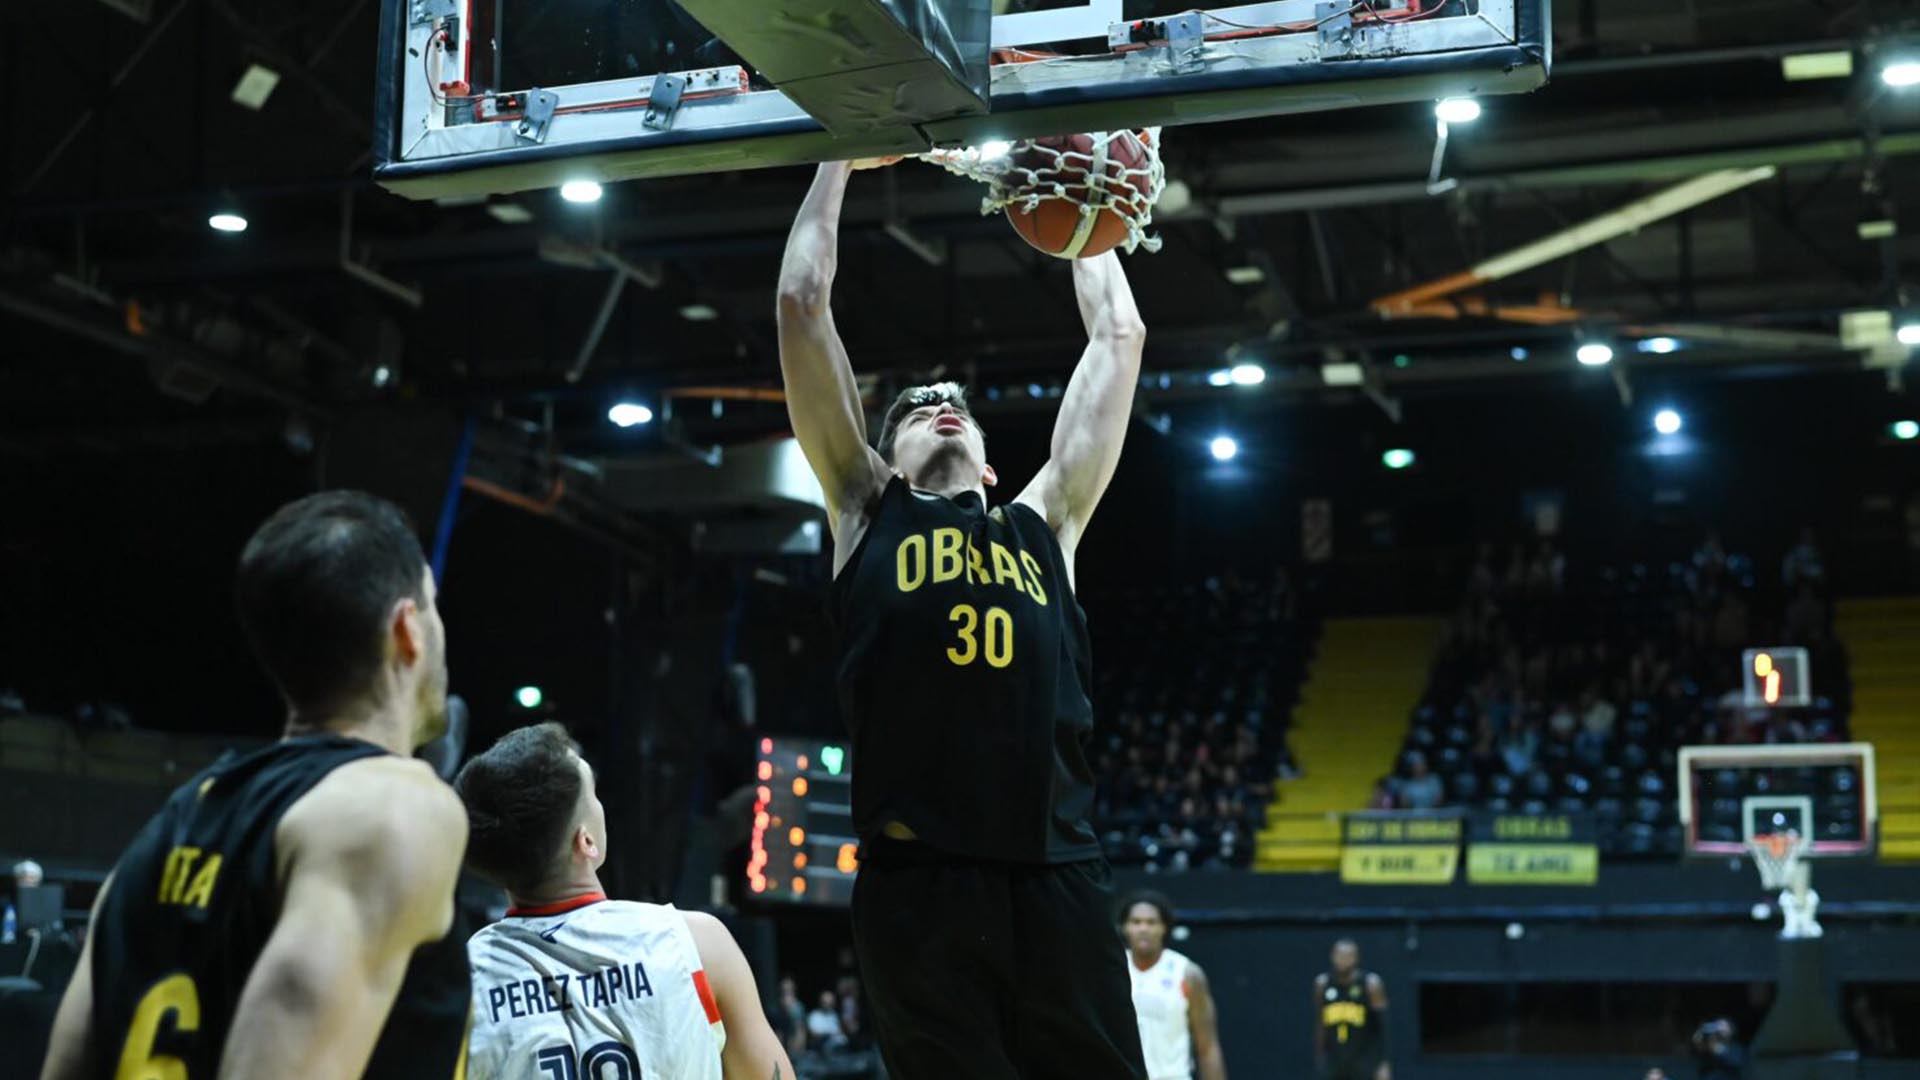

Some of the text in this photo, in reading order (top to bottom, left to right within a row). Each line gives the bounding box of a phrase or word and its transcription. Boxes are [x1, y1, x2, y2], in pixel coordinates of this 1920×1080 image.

[896, 527, 1048, 606] OBRAS
[946, 603, 1014, 668] 30
[489, 962, 654, 1022] PEREZ TAPIA
